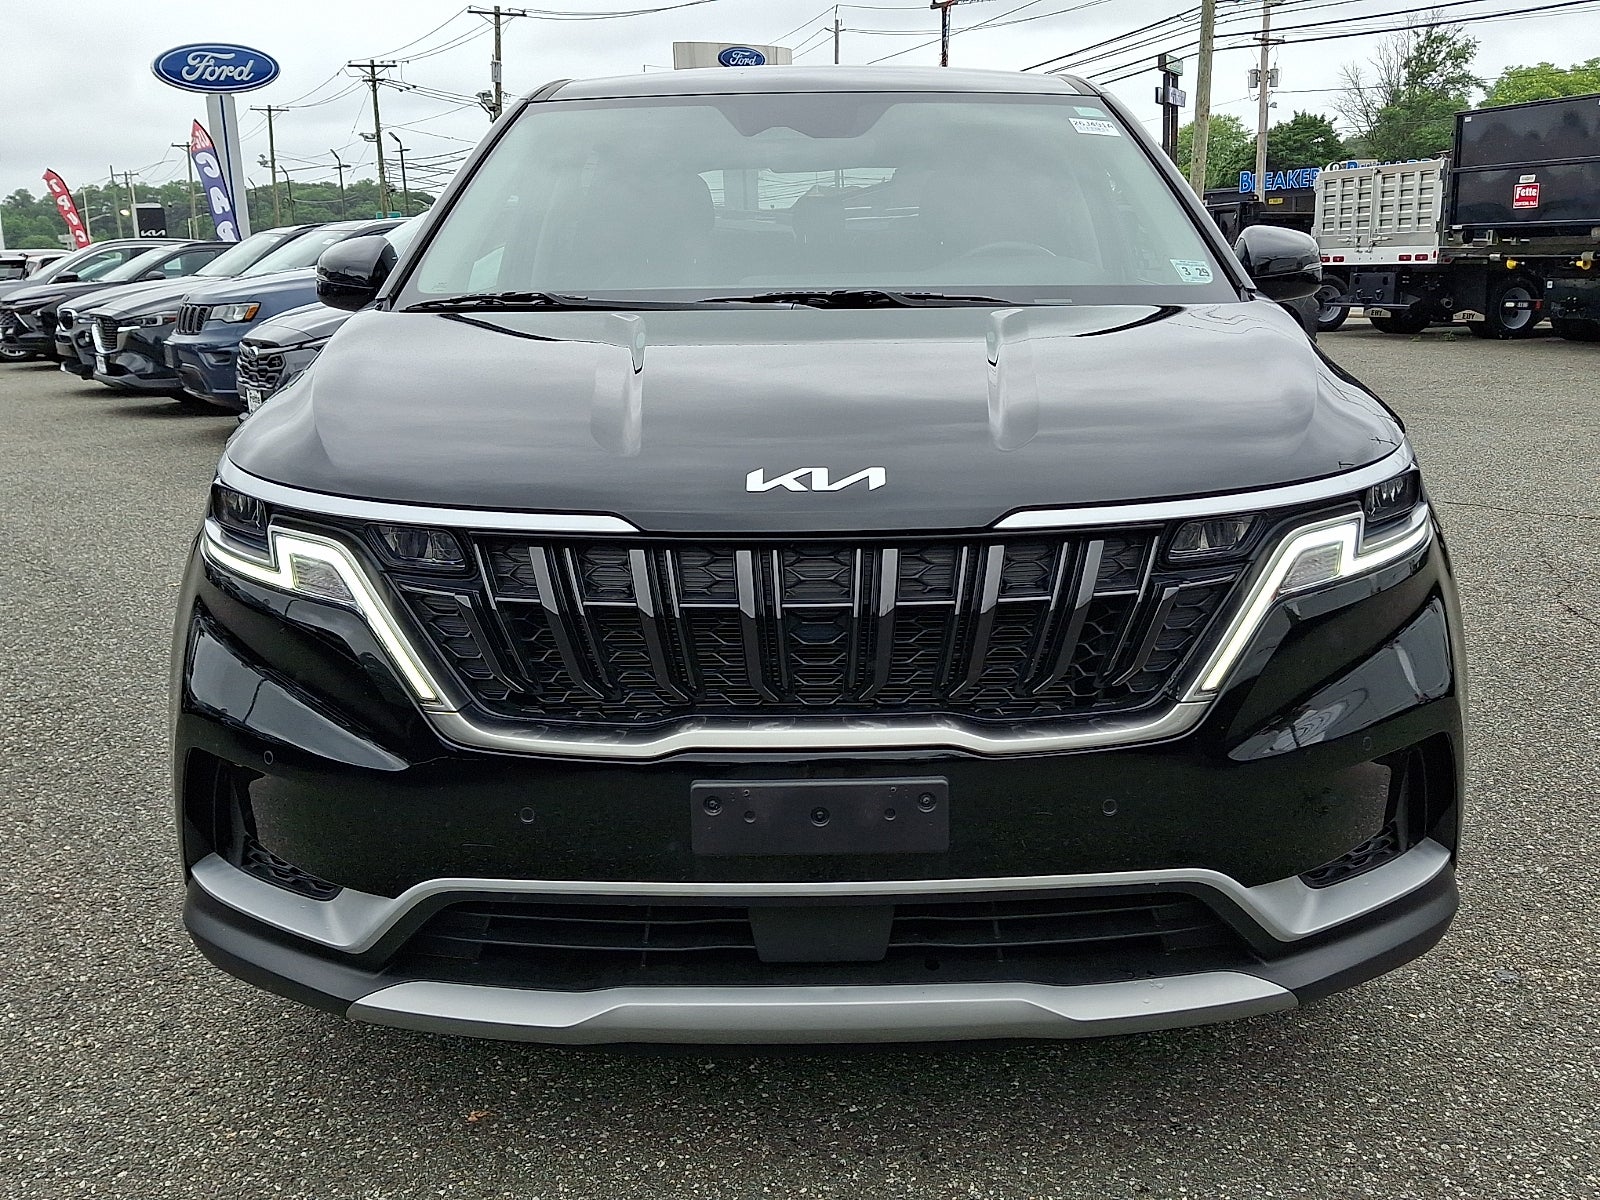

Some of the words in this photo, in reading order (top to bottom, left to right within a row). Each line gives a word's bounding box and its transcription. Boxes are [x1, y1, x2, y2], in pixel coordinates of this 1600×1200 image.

[729, 50, 757, 65] Ford
[181, 51, 254, 81] Ford
[1515, 186, 1537, 200] Fette
[140, 229, 166, 237] KIA
[1181, 266, 1192, 276] 3
[1195, 267, 1210, 277] 29
[746, 466, 887, 492] KIA
